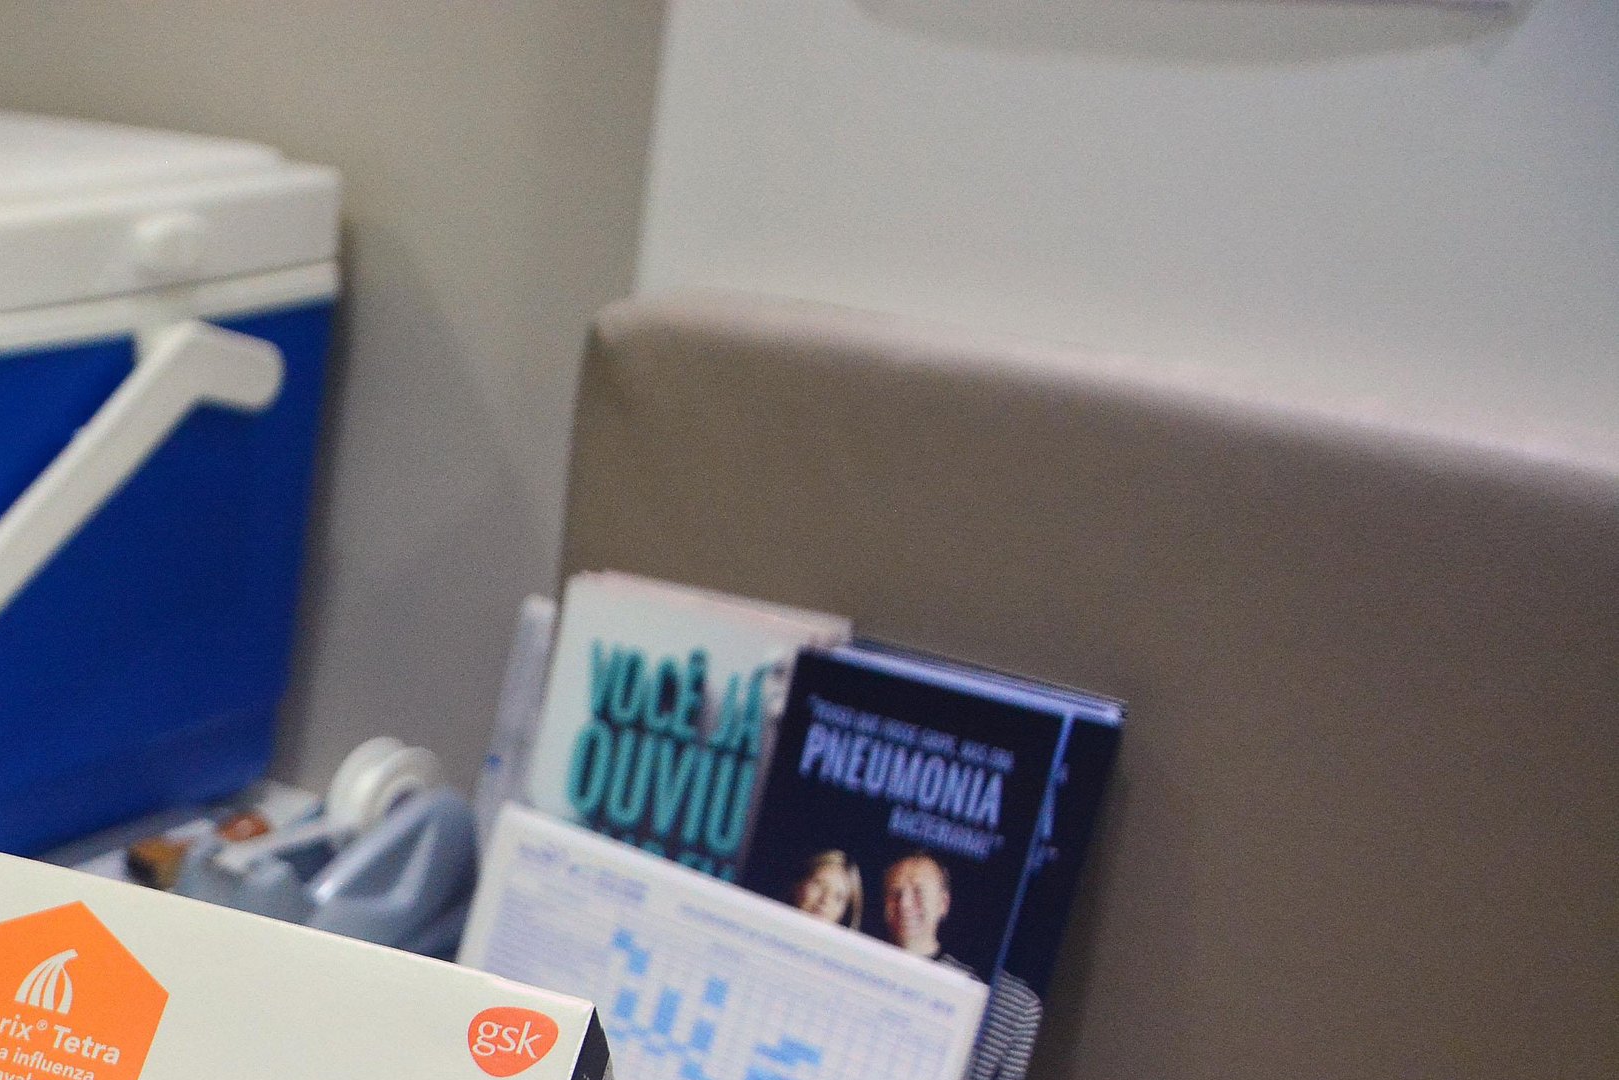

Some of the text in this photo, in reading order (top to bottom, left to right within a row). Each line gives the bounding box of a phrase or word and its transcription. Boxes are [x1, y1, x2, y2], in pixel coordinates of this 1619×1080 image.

[567, 720, 759, 855] OUVIU
[798, 722, 1003, 828] PNEUMONIA
[53, 1024, 120, 1065] Tetra
[472, 1021, 542, 1059] gsk
